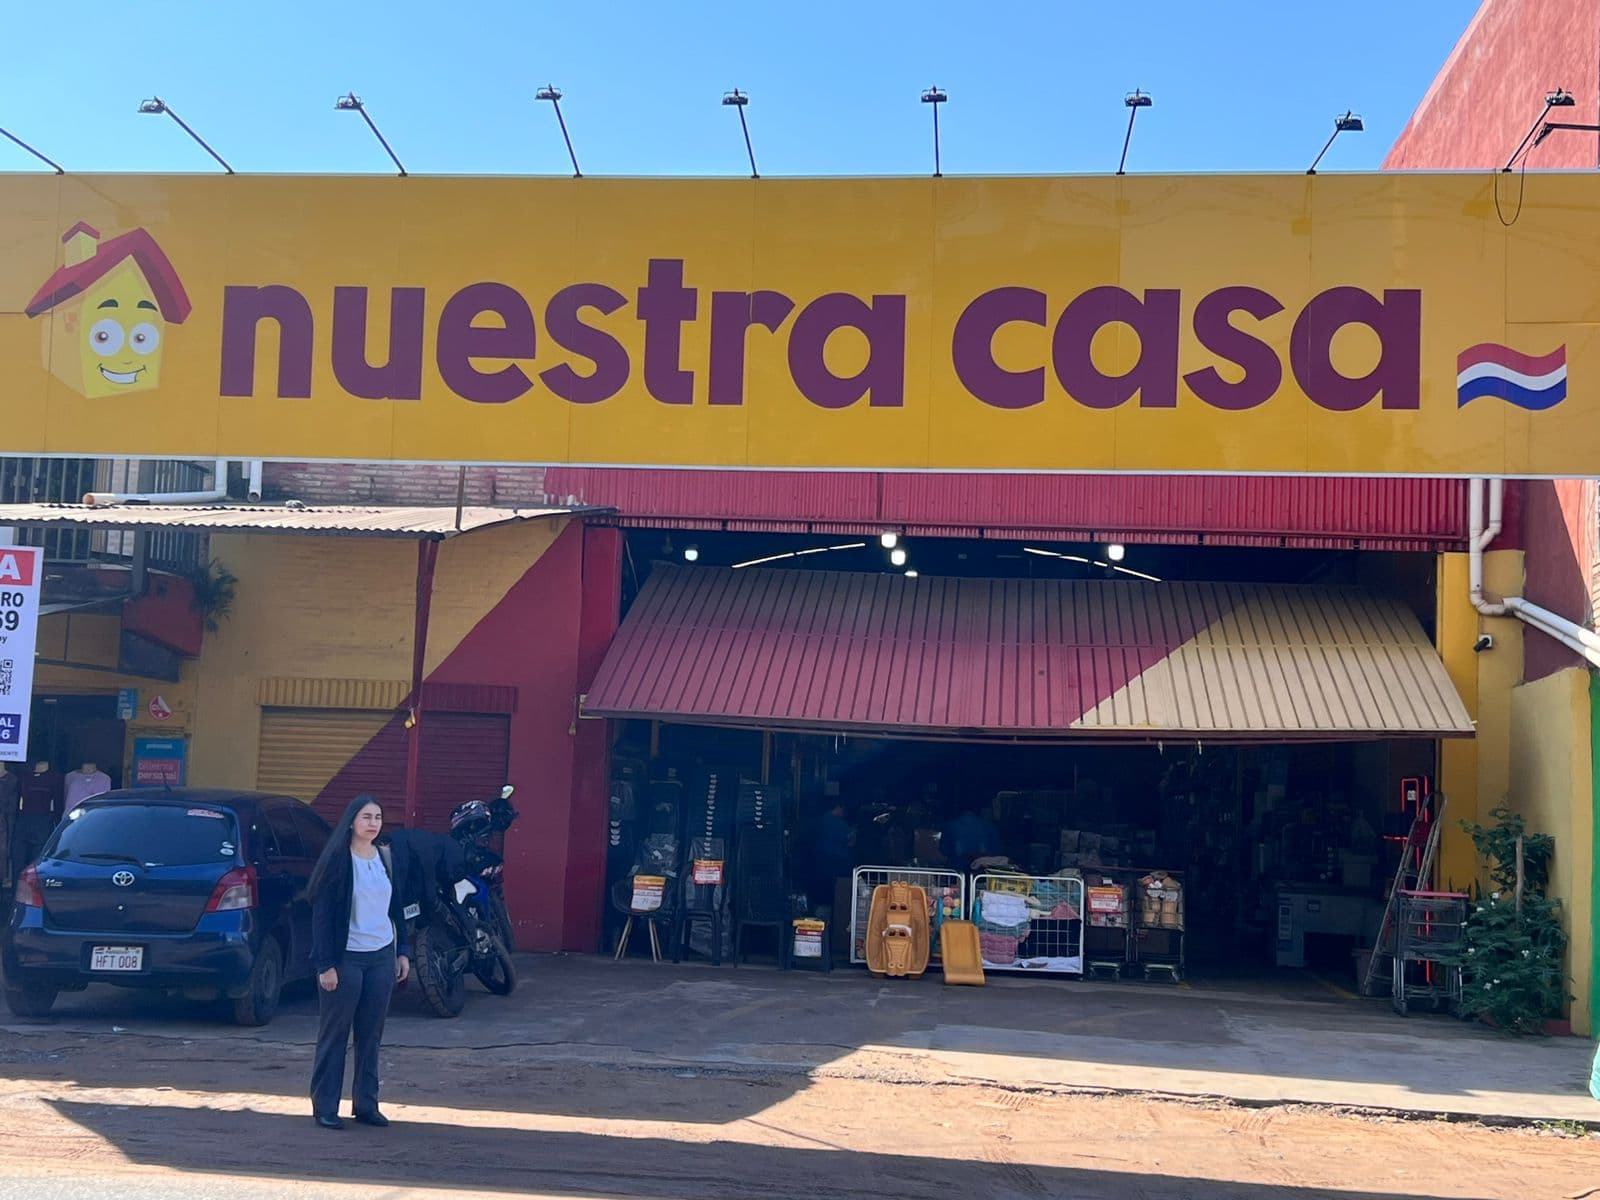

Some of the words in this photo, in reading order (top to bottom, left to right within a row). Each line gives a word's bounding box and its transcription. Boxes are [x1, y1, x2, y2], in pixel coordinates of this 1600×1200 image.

[219, 258, 906, 410] nuestra
[951, 285, 1422, 412] casa
[0, 553, 21, 581] A
[1, 591, 24, 608] RO
[0, 610, 19, 632] 9
[0, 717, 15, 728] AL
[0, 728, 11, 740] 6
[95, 955, 116, 968] HFT
[118, 955, 138, 968] 008
